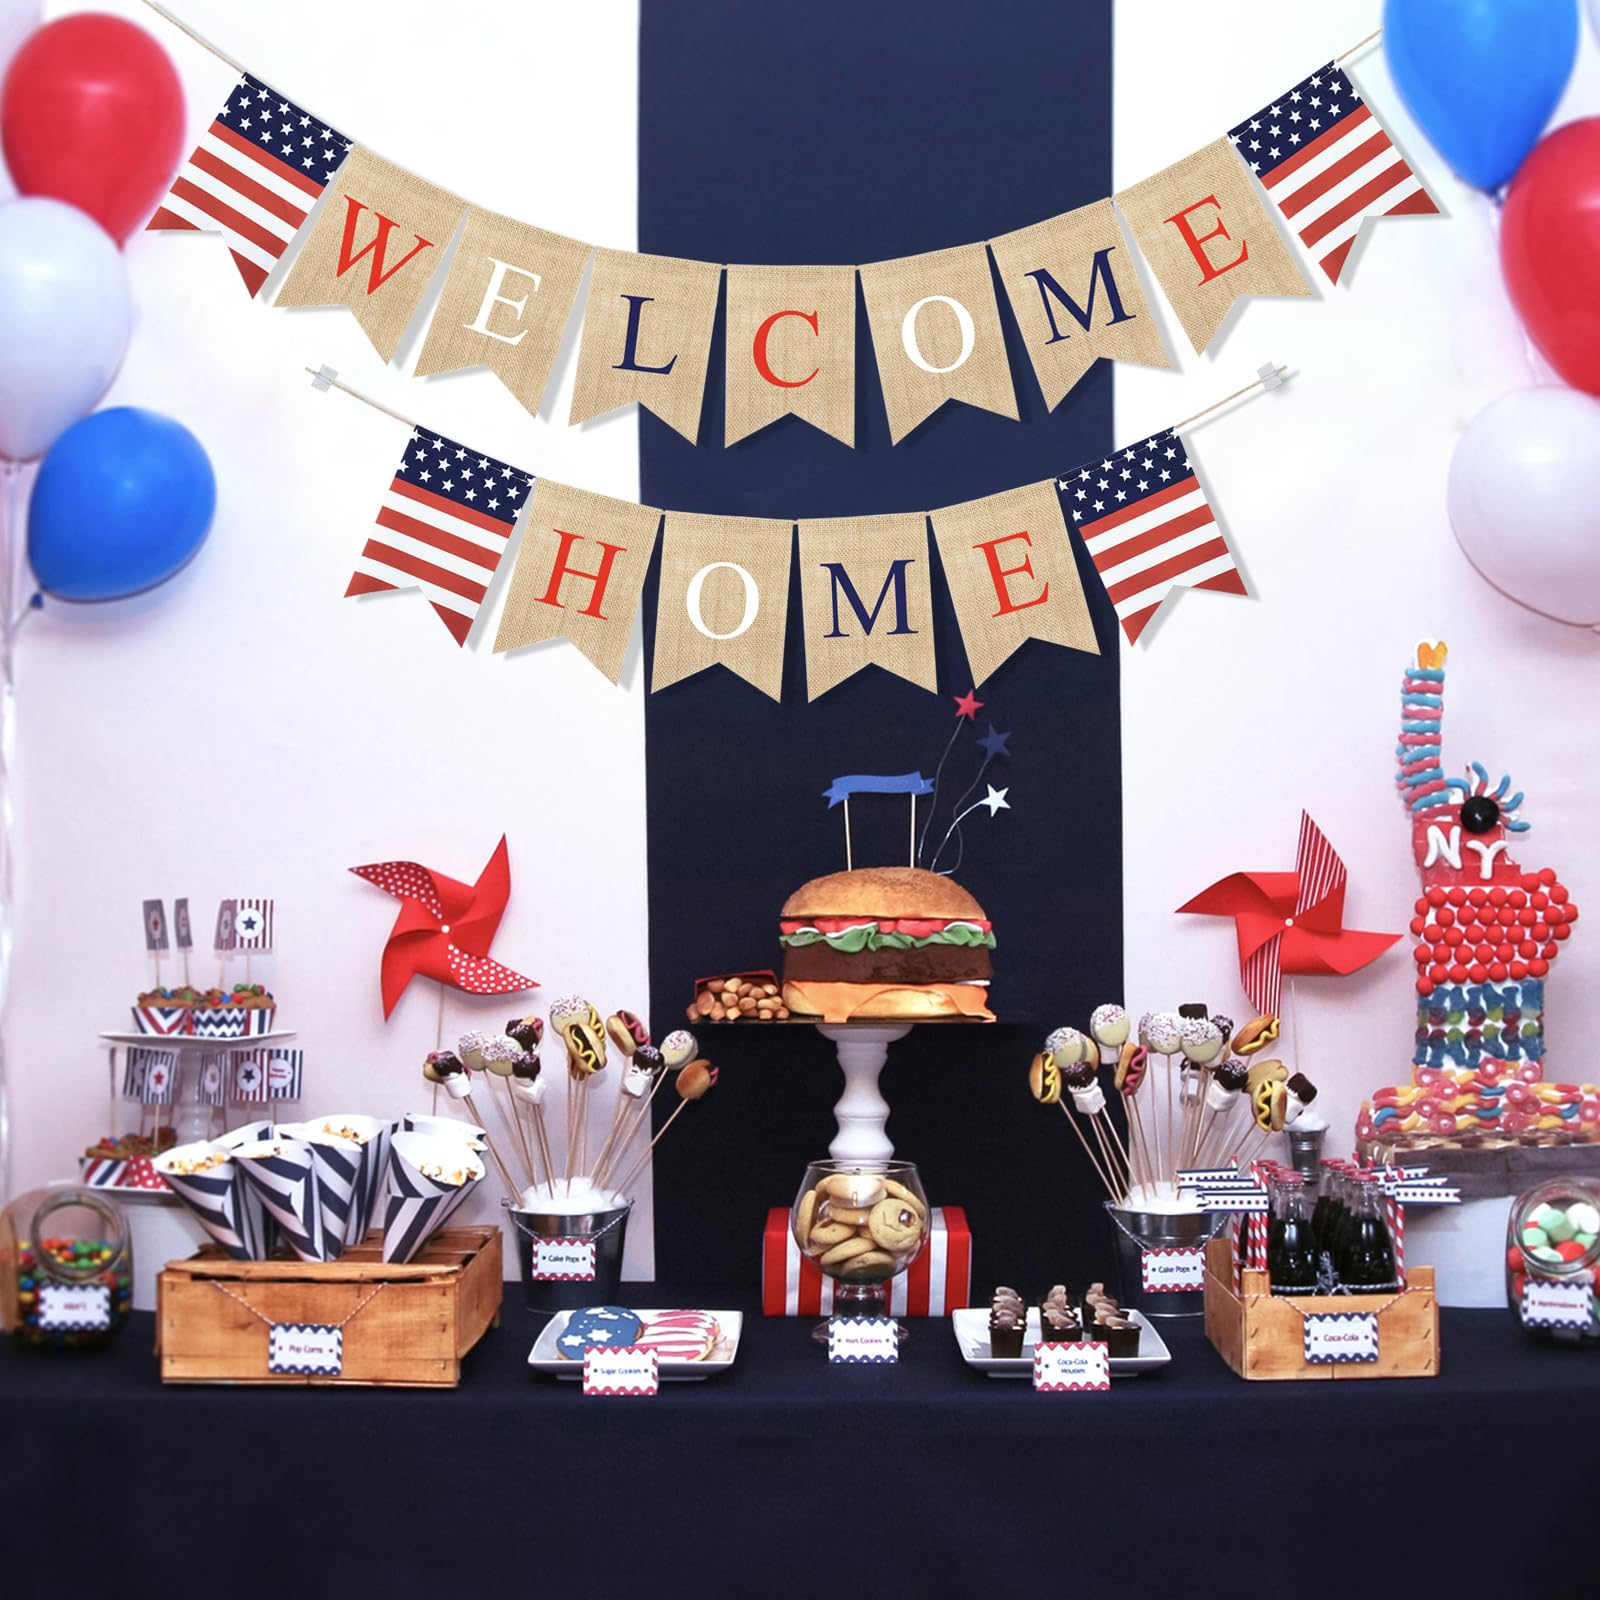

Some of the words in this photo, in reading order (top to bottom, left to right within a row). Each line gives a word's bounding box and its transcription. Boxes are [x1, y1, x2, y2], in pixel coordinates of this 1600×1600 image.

[336, 195, 1249, 389] WELCOME
[536, 529, 1049, 640] HOME
[1423, 824, 1509, 880] NY
[565, 1255, 580, 1263] Pops
[1158, 1265, 1174, 1273] Cake
[1175, 1265, 1191, 1273] Pops
[1323, 1333, 1359, 1342] Coca-Cola
[1057, 1358, 1088, 1366] Coca-Cola
[600, 1367, 616, 1375] Sugar
[618, 1367, 642, 1375] Cookies
